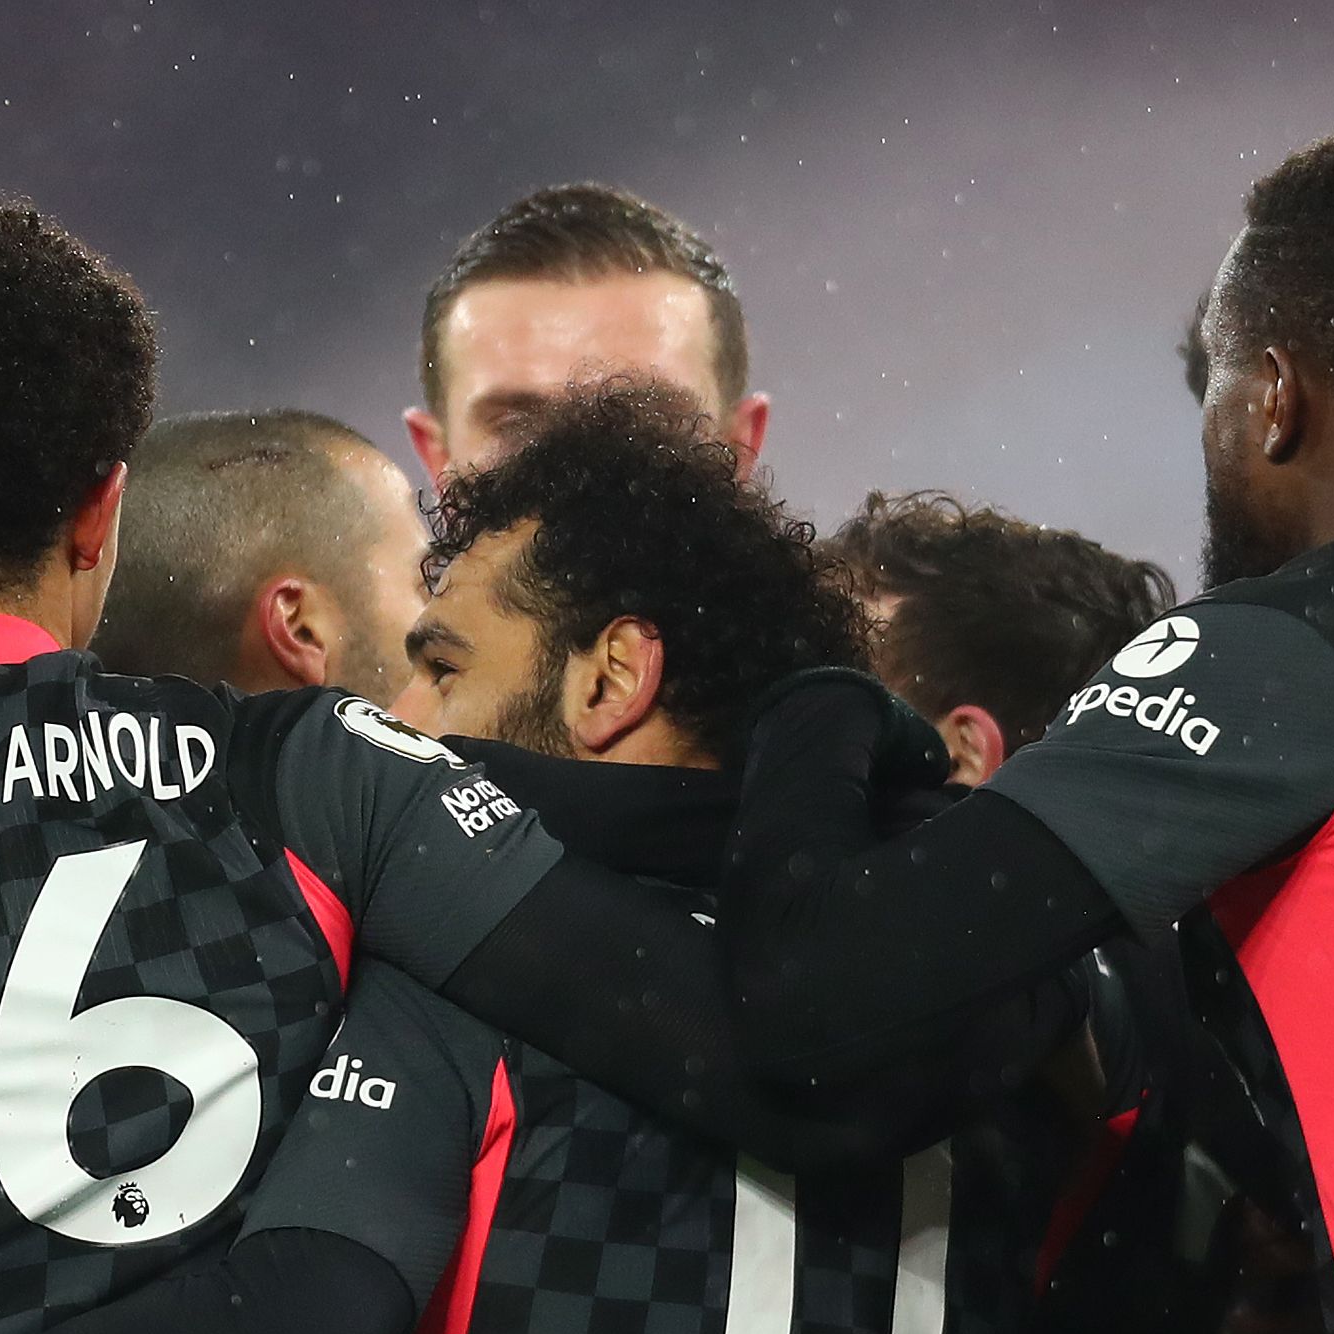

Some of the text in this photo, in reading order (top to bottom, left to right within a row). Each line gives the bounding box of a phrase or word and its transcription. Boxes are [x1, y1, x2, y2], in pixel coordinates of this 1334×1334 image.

[441, 787, 480, 819] No
[457, 805, 494, 838] for
[309, 1054, 397, 1110] dia
